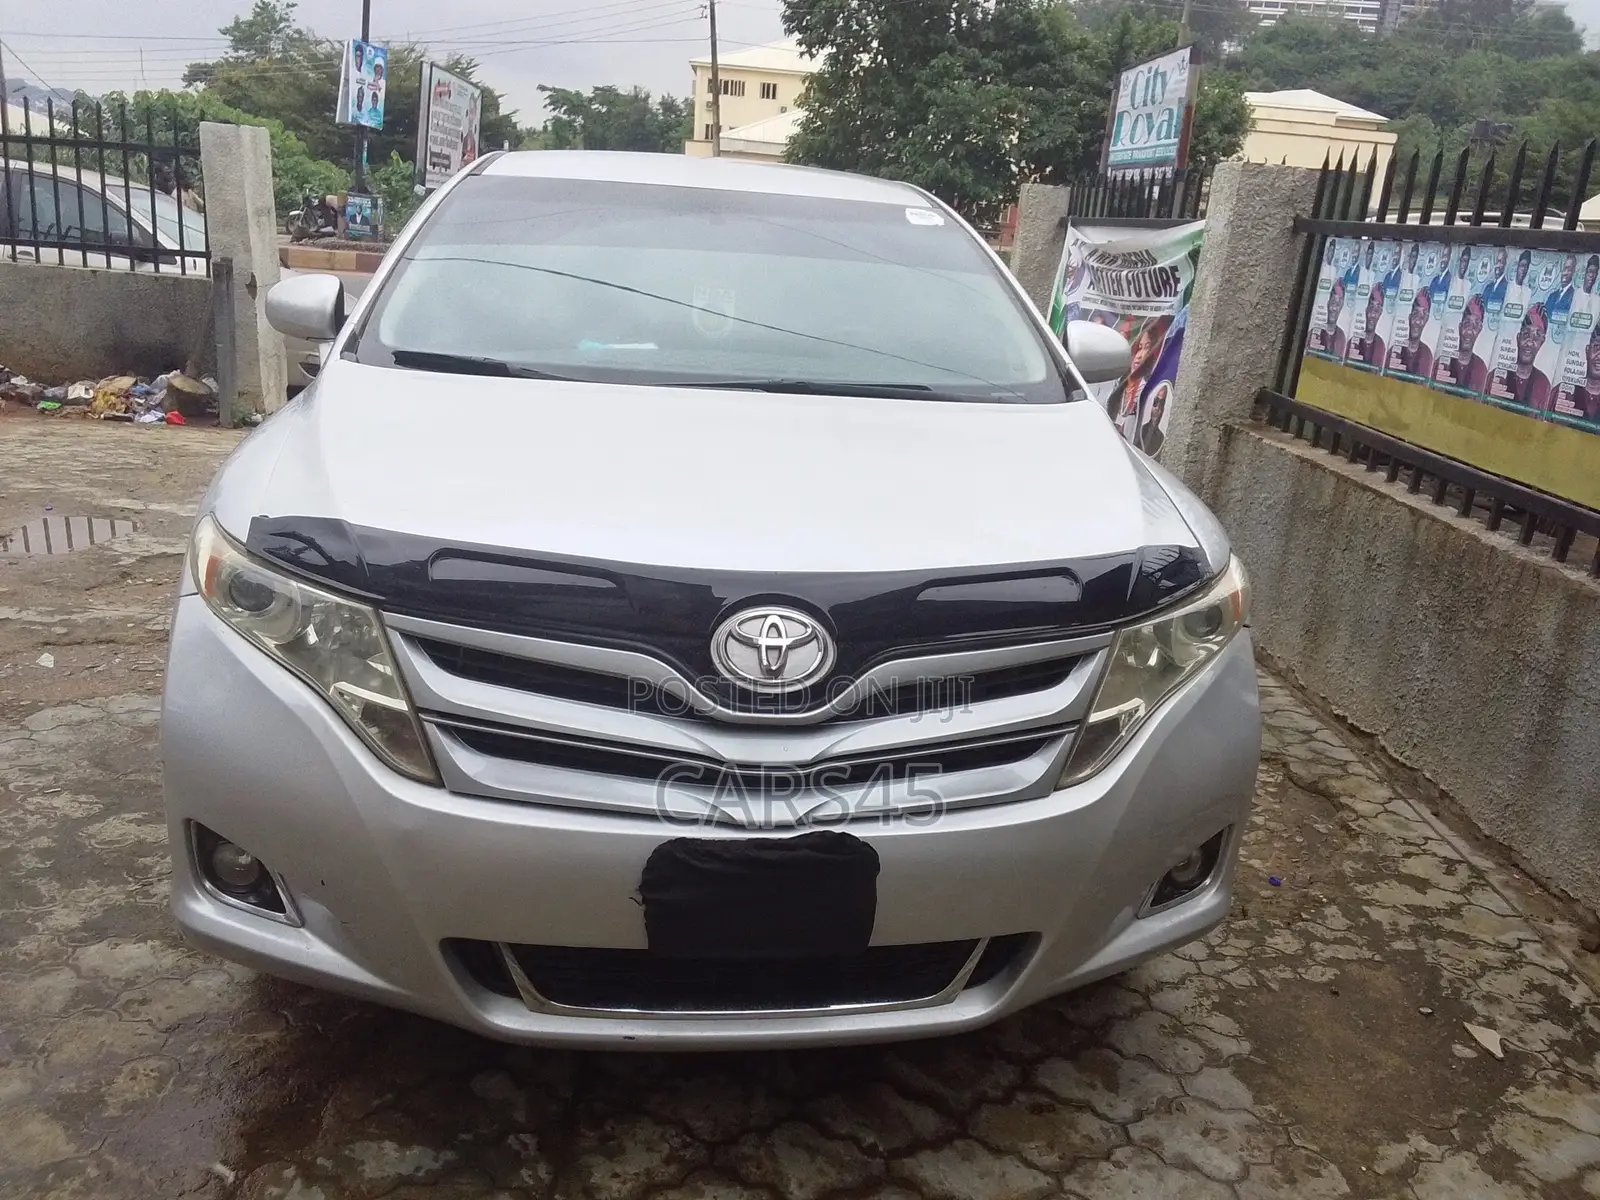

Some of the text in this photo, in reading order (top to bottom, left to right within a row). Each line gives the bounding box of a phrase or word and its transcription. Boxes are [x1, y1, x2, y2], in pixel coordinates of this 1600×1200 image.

[1131, 64, 1174, 110] City
[1112, 97, 1184, 147] Royal
[1125, 265, 1181, 298] FUTURE
[1565, 359, 1586, 367] SUNDAY
